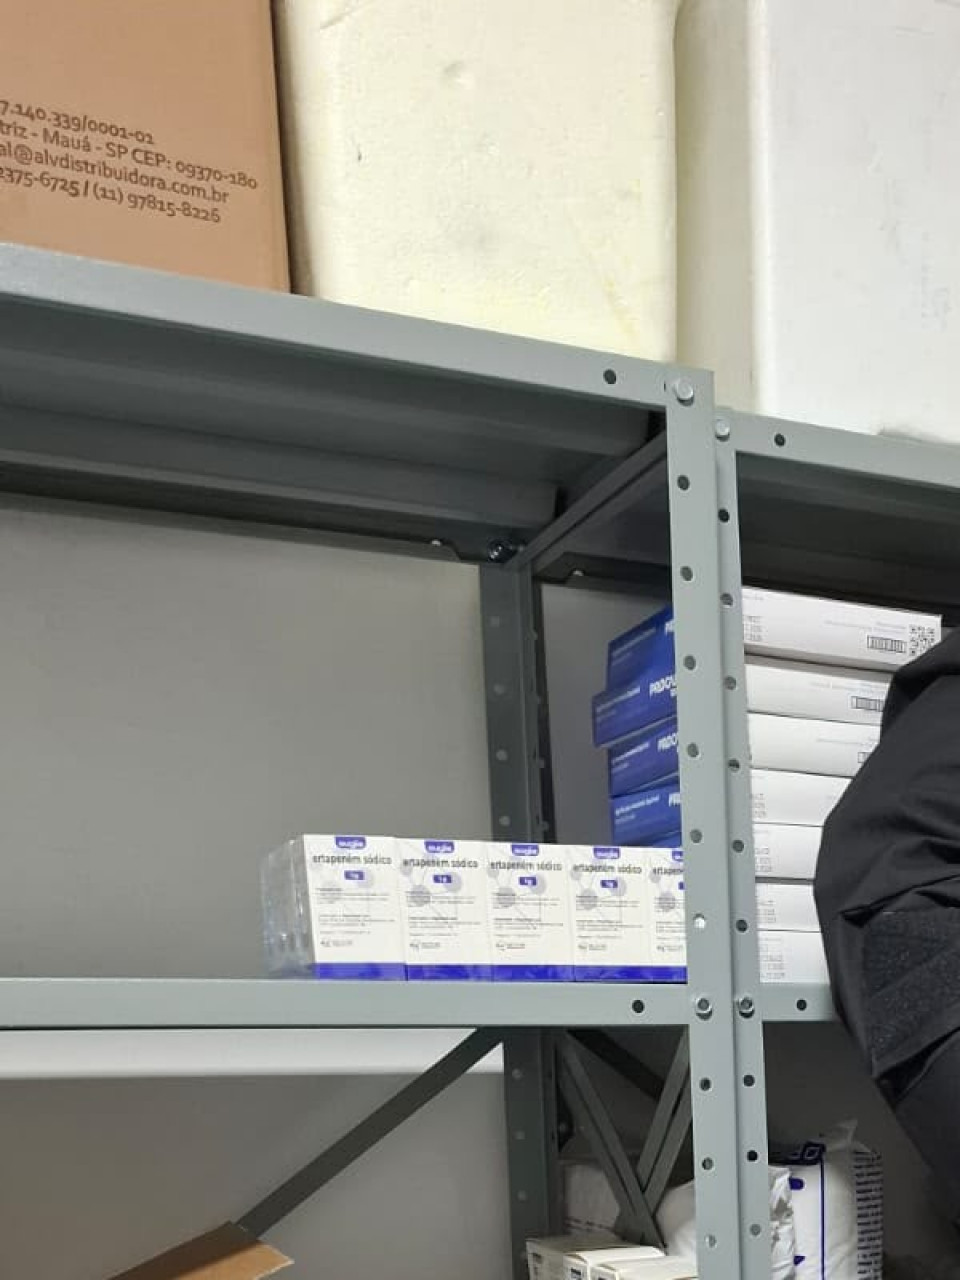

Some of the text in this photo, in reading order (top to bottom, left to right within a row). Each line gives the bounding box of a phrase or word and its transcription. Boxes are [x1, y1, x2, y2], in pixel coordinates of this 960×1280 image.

[42, 127, 92, 153] Mauá
[105, 141, 129, 160] SP
[132, 147, 171, 171] CEP:
[175, 160, 258, 190] 09370-180
